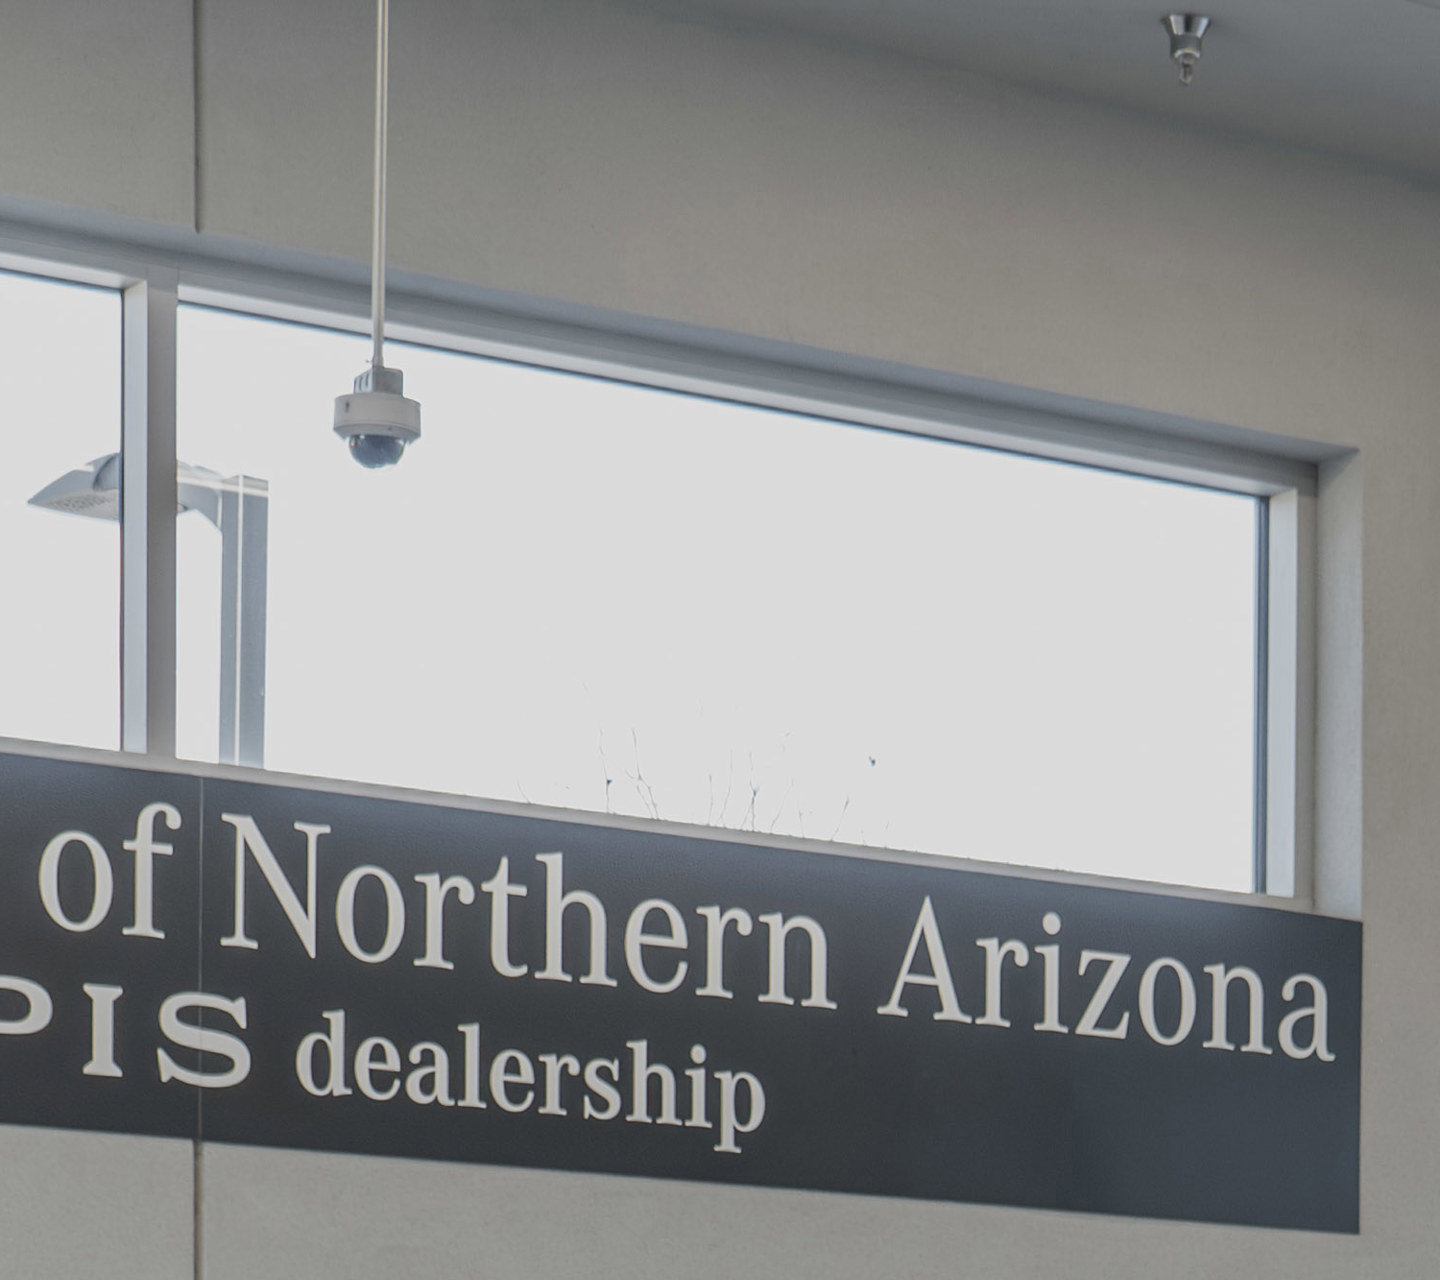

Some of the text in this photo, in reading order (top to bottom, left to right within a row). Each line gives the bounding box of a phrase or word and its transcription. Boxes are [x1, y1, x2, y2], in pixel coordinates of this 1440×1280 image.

[38, 801, 183, 940] of
[219, 811, 838, 1011] Northern
[875, 894, 1336, 1063] Arizona
[295, 1009, 766, 1155] dealership
